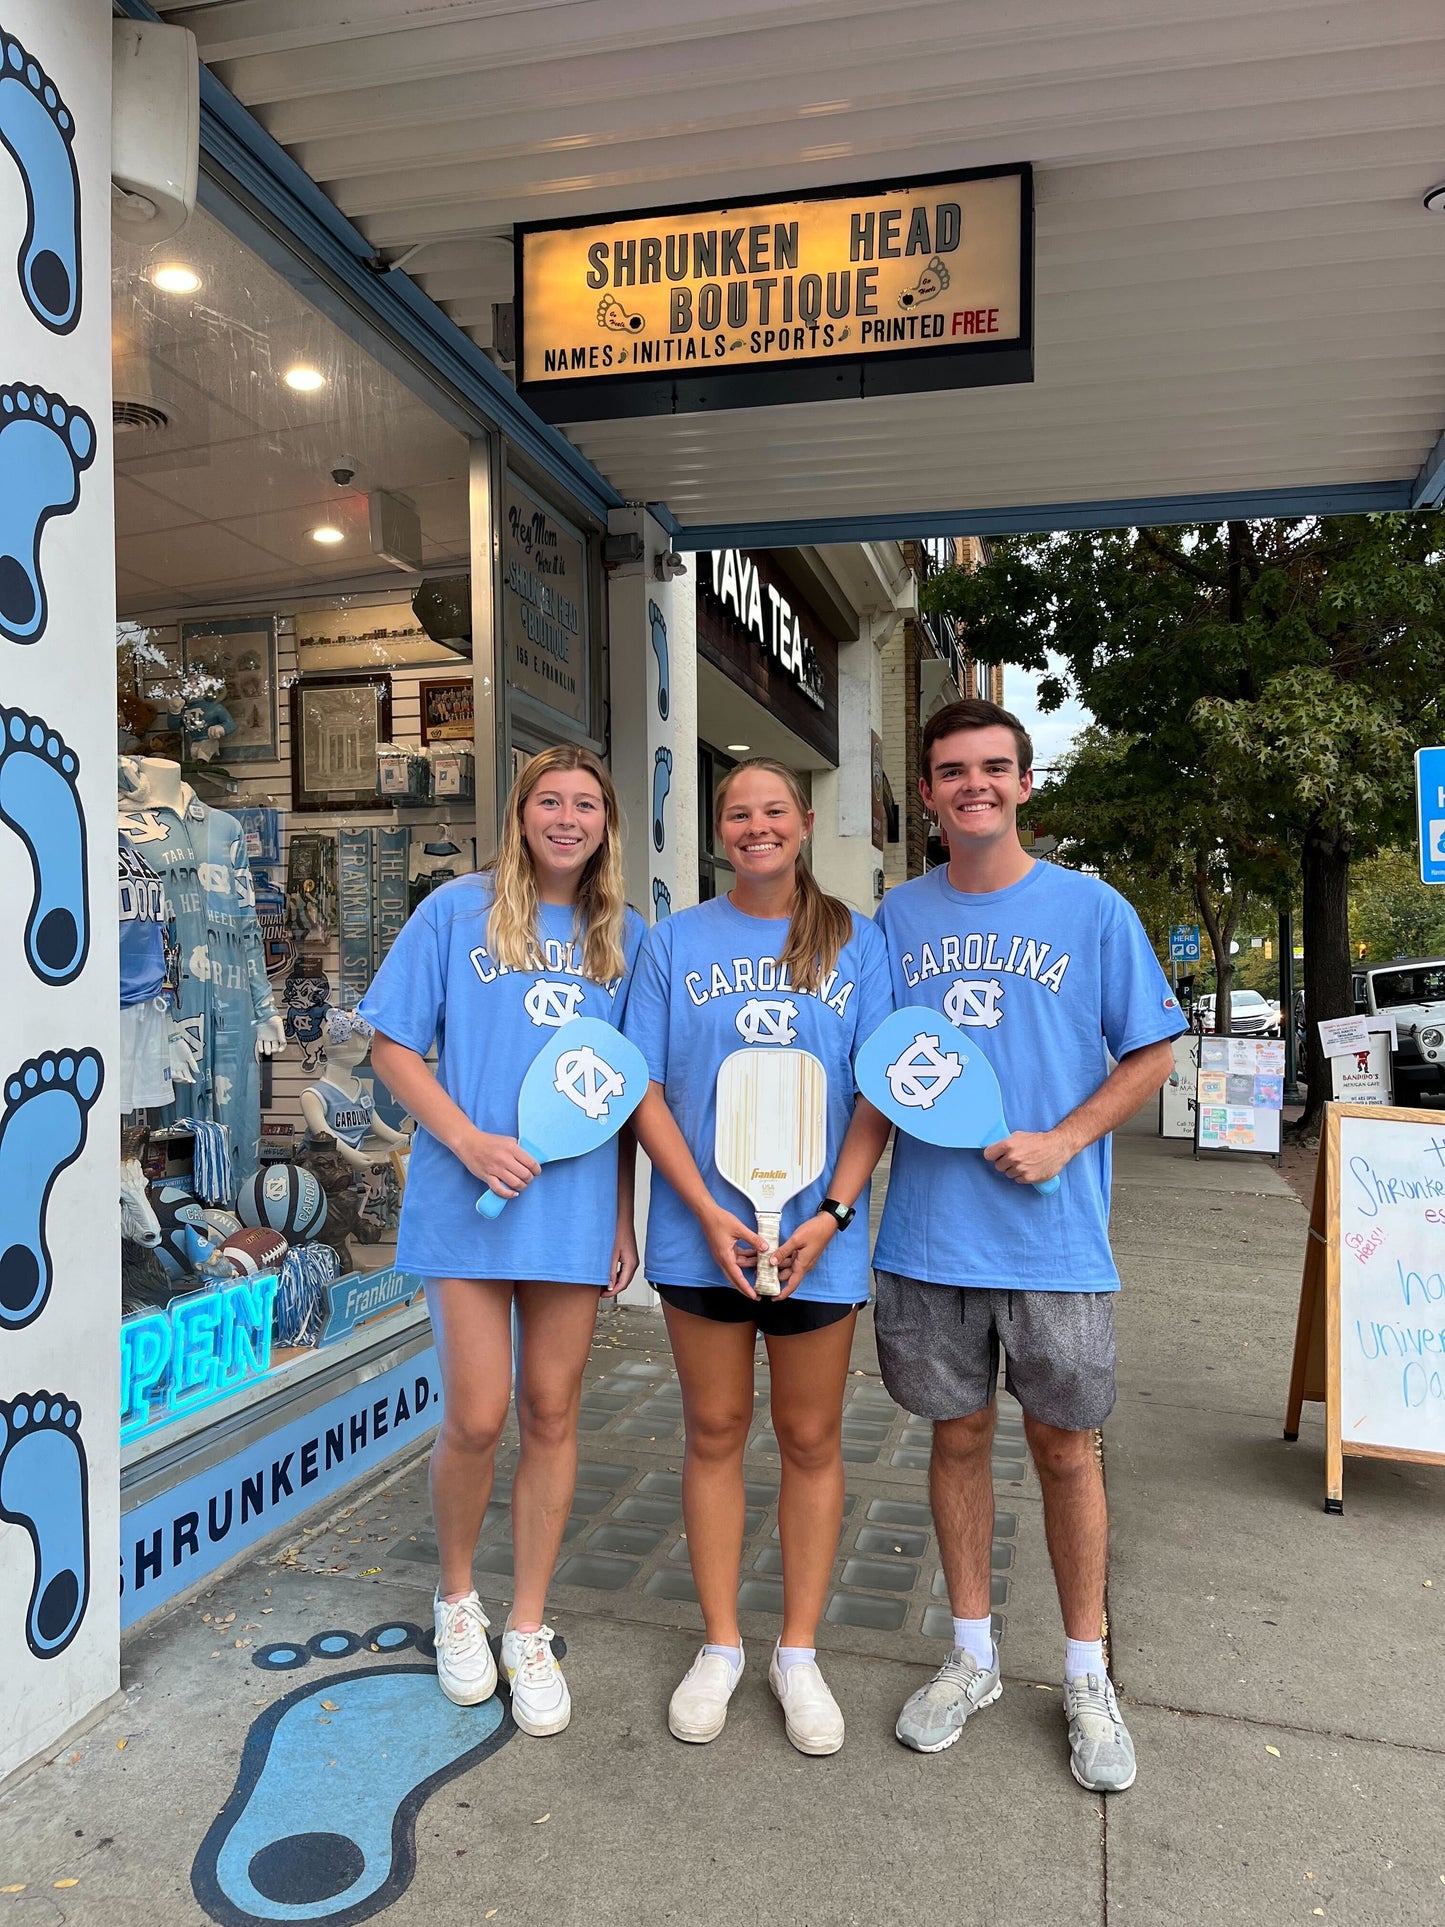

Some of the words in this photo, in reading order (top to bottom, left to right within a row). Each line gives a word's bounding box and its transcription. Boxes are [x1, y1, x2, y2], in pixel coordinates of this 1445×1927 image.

[586, 222, 799, 291] SHRUNKEN
[849, 203, 962, 263] HEAD
[670, 266, 879, 335] BOUTIQUE
[544, 344, 614, 373] NAMES
[632, 334, 727, 366] INITIALS
[750, 324, 835, 355] SPORTS
[861, 313, 945, 346] PRINTED
[951, 307, 1000, 337] FREE
[508, 505, 533, 554] Hey
[532, 512, 557, 548] Mom
[508, 559, 555, 621] SHRUNKEN
[556, 593, 579, 636] HEAD
[527, 612, 570, 665] BOUTIQUE
[768, 583, 804, 683] TEA
[516, 644, 529, 667] 155
[541, 656, 576, 695] FRANKLIN
[162, 848, 186, 865] TAR
[381, 847, 404, 882] THE
[342, 843, 367, 940] FRANKLIN
[901, 932, 1071, 994] CAROLINA
[1184, 986, 1190, 994] P
[335, 1109, 372, 1129] CAROLINA
[345, 1274, 403, 1320] Franklin
[1397, 1259, 1445, 1306] ha
[119, 1274, 279, 1436] PEN
[1403, 1361, 1445, 1408] Da
